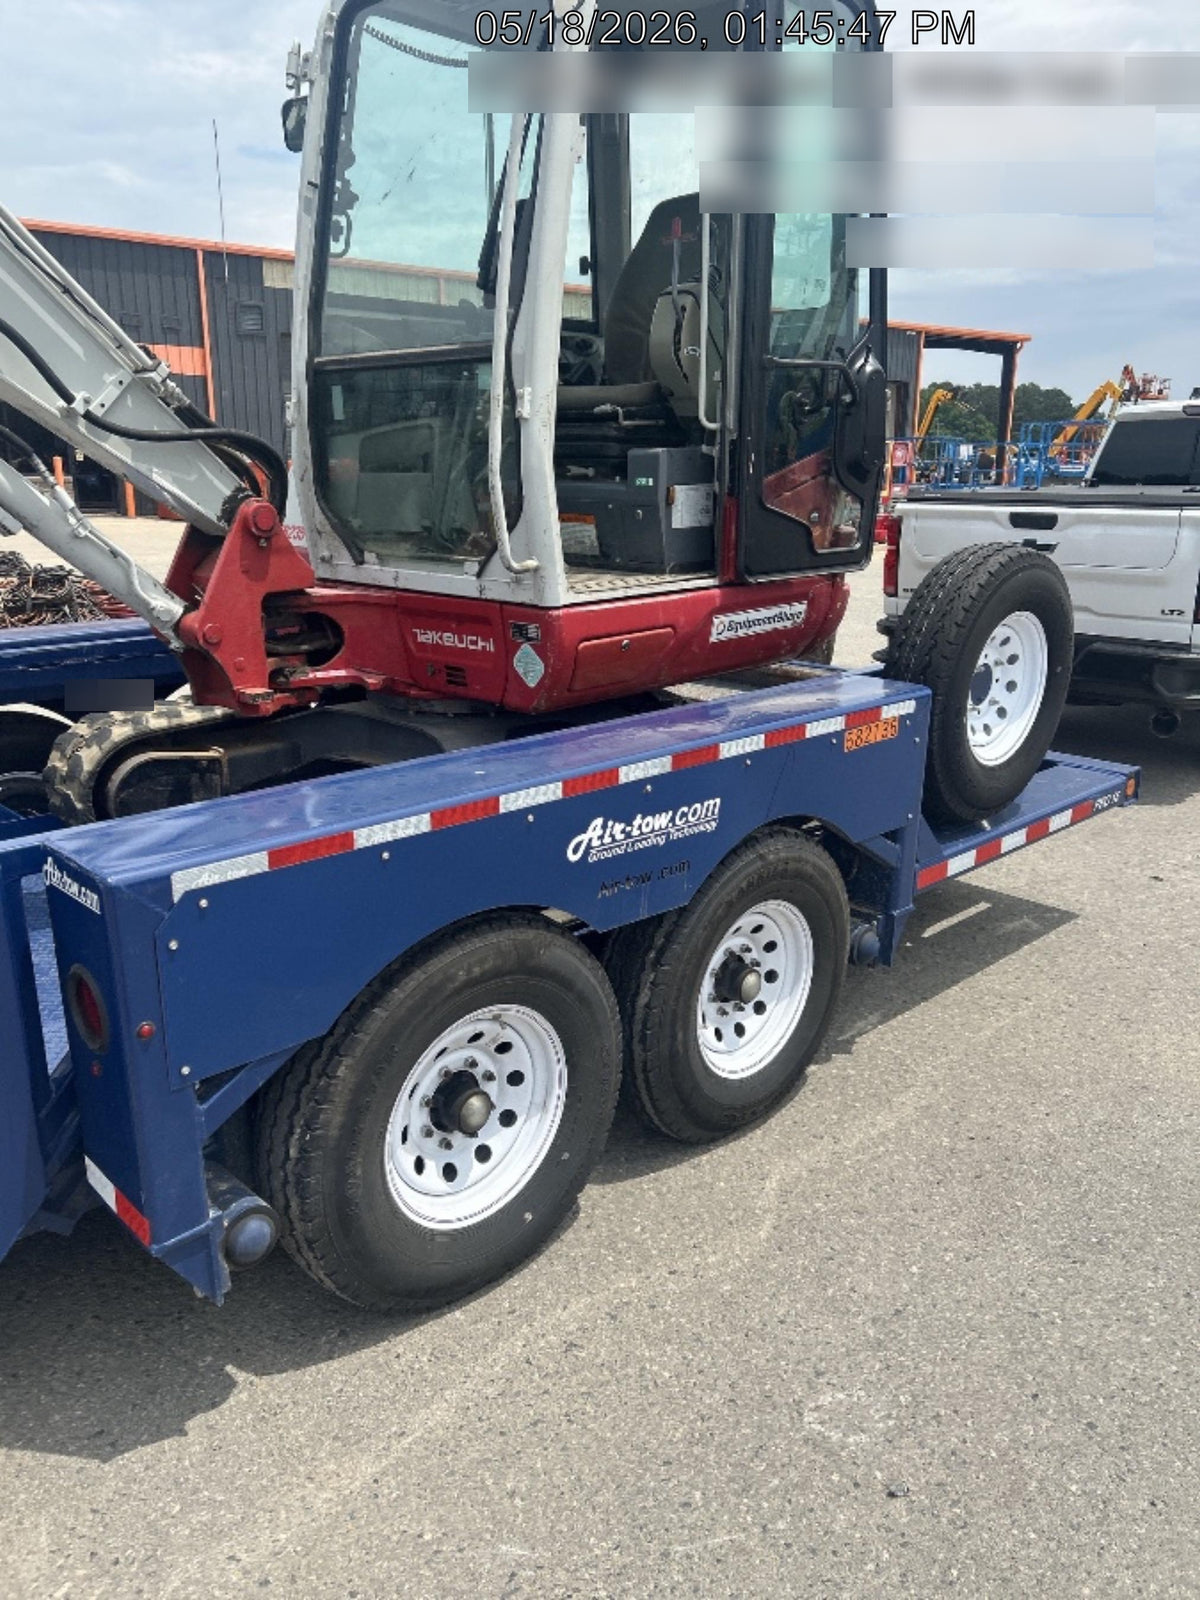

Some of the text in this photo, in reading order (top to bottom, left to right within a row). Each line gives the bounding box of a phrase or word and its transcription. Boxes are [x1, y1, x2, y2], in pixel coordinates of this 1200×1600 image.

[566, 798, 720, 862] Air-tow.com
[588, 819, 719, 863] Ground Loading Technology
